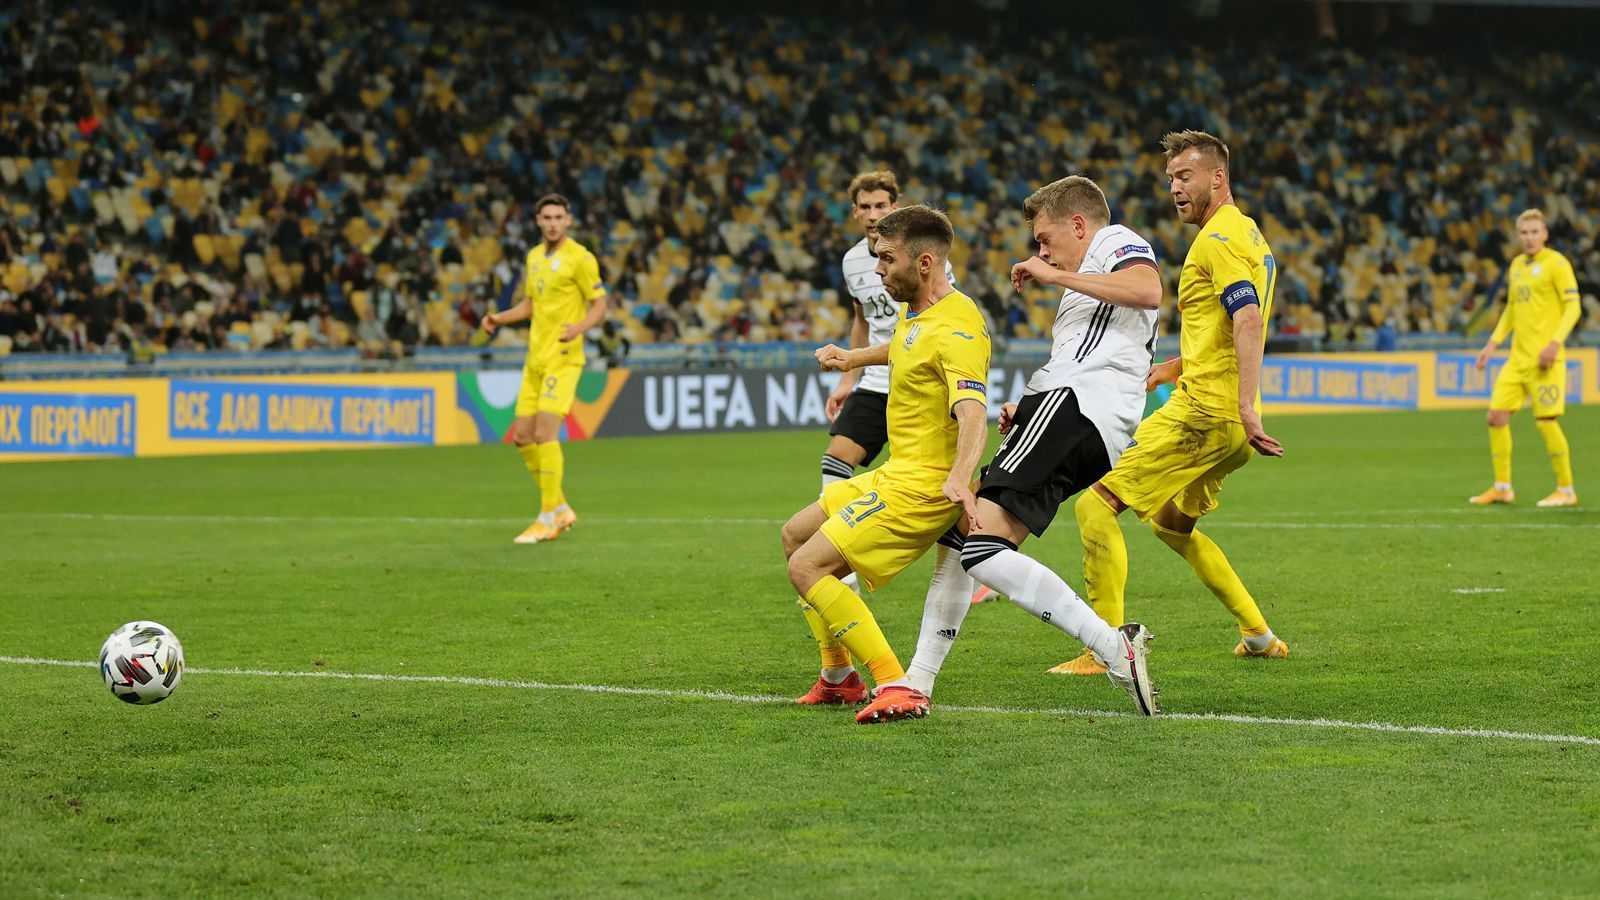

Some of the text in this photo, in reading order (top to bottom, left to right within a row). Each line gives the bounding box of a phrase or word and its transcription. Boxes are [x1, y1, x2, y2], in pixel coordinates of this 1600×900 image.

[866, 293, 895, 319] 18
[545, 375, 558, 393] 9
[1537, 384, 1560, 405] 20
[174, 391, 431, 437] ВСЕ ДЛЯ ВАШИХ ПЕРЕМОГ!
[644, 372, 843, 431] UEFA NAT
[31, 401, 131, 446] ПЕРЕМОГ!
[845, 491, 886, 522] 21
